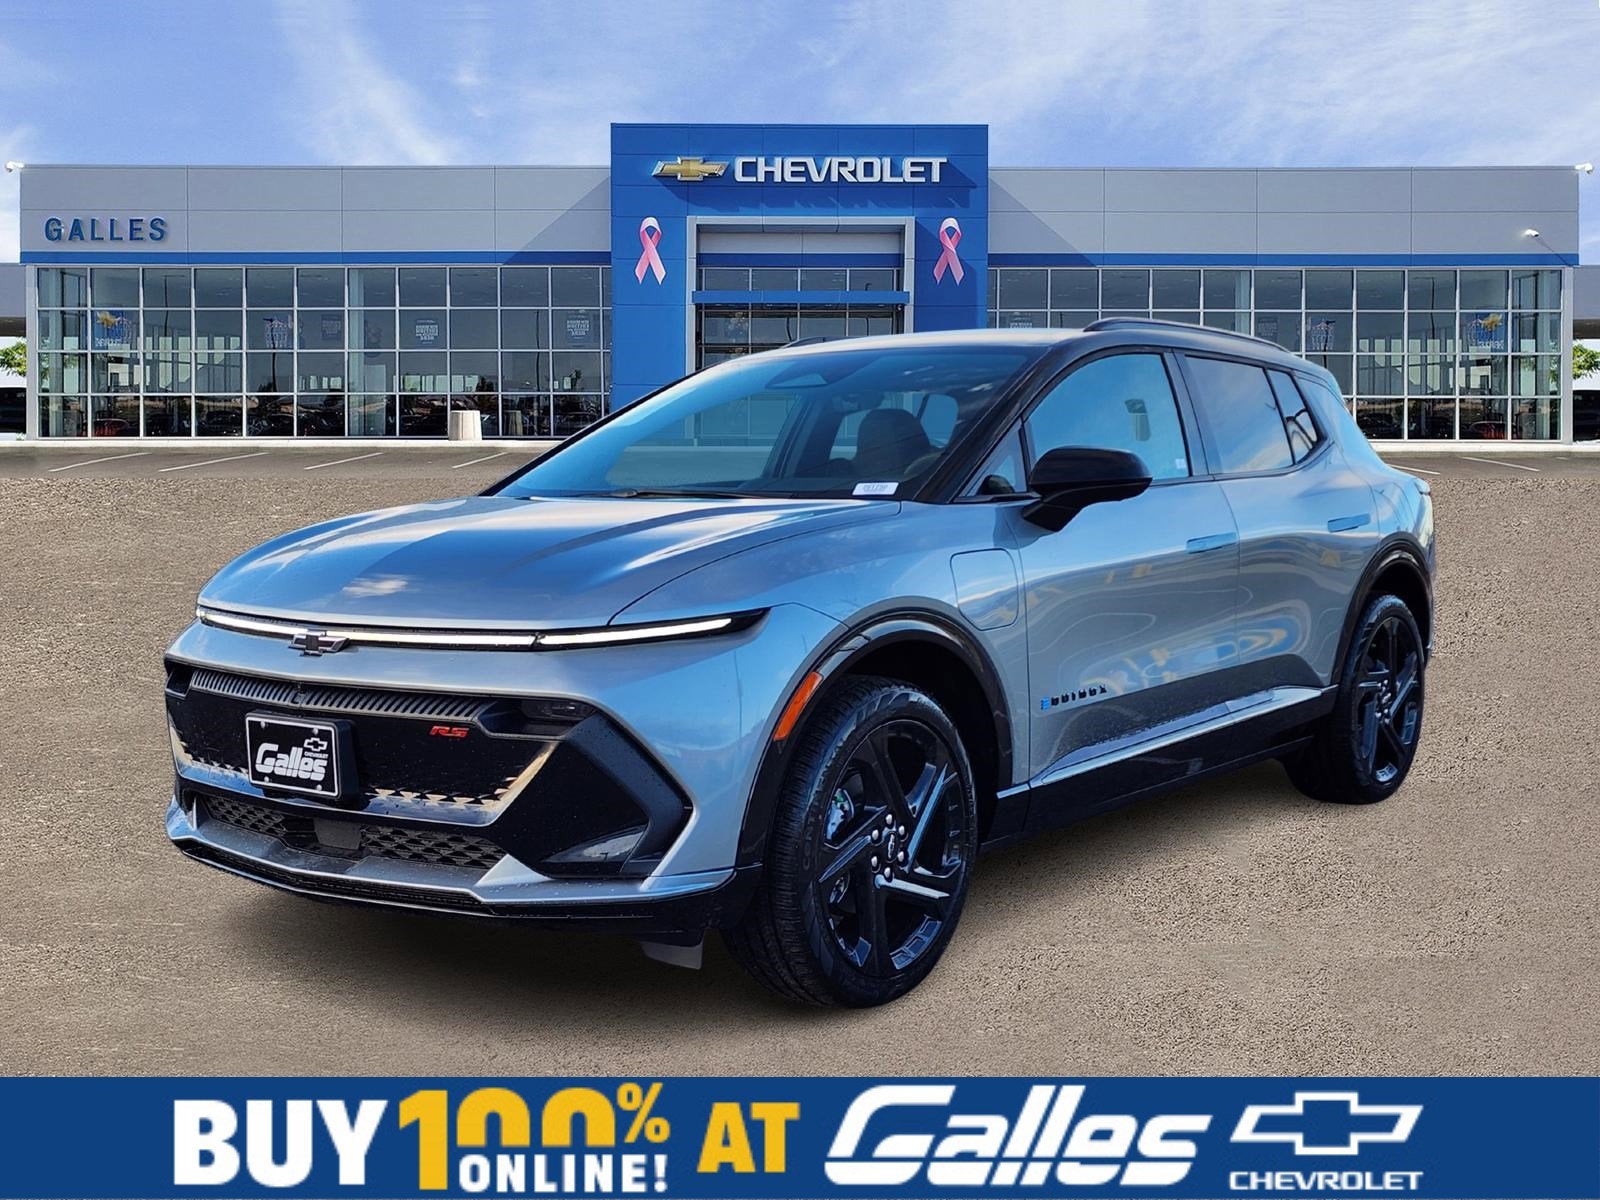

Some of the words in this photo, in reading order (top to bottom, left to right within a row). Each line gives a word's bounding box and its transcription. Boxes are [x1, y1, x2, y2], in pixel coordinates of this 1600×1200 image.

[734, 157, 947, 183] CHEVROLET
[44, 217, 166, 241] GALLES
[430, 726, 470, 738] RS
[255, 742, 329, 781] Galles
